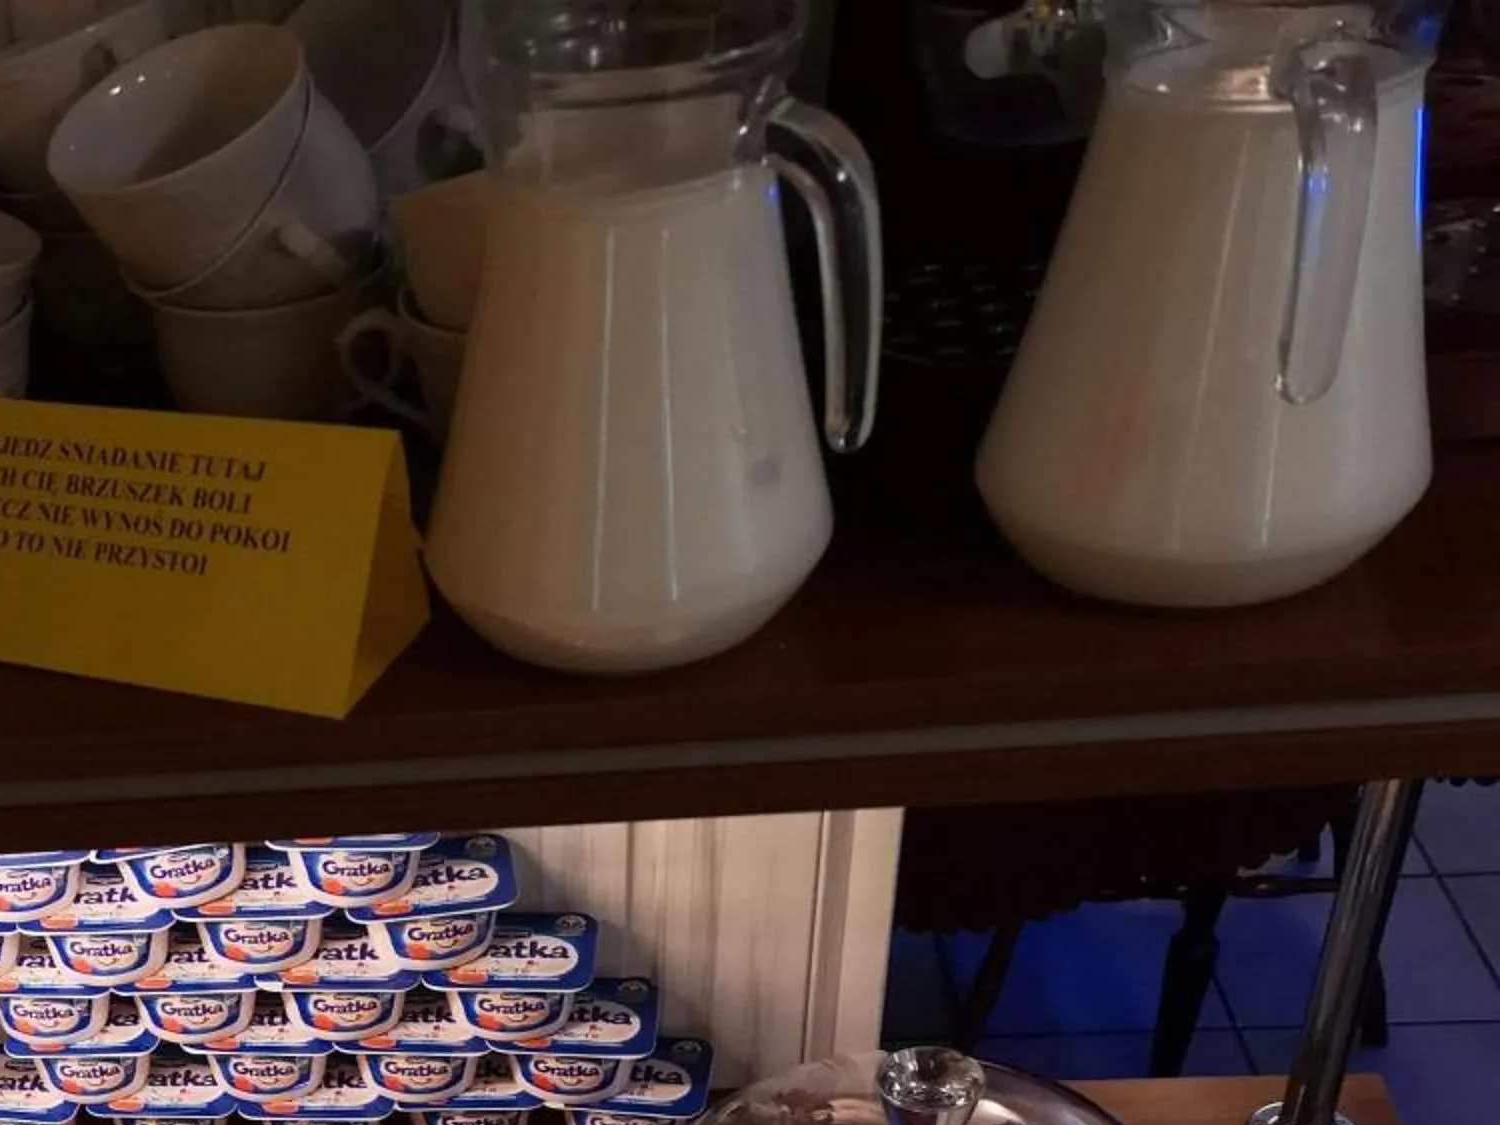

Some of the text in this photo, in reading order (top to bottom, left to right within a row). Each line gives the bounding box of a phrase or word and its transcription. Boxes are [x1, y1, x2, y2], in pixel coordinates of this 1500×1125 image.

[190, 453, 268, 483] TUTAJ
[65, 475, 184, 509] BRZUSZEK
[192, 487, 253, 515] BOLI
[37, 501, 75, 526] NIE
[169, 517, 204, 543] DO
[14, 529, 45, 553] TO
[51, 535, 88, 561] NIE
[93, 541, 209, 577] PRZYSTOI
[149, 857, 216, 880] Gratka
[322, 860, 392, 878] Gratka
[224, 928, 290, 945] Gratka
[407, 918, 475, 942] Gratka
[70, 941, 133, 957] Gratka
[12, 1004, 75, 1020] Gratka
[161, 1001, 224, 1018] Gratka
[313, 997, 378, 1014] Gratka
[478, 998, 545, 1015] Gratka
[59, 1064, 121, 1080] Gratka
[233, 1061, 296, 1077] Gratka
[384, 1061, 448, 1077] Gratka
[533, 1060, 599, 1078] Gratka
